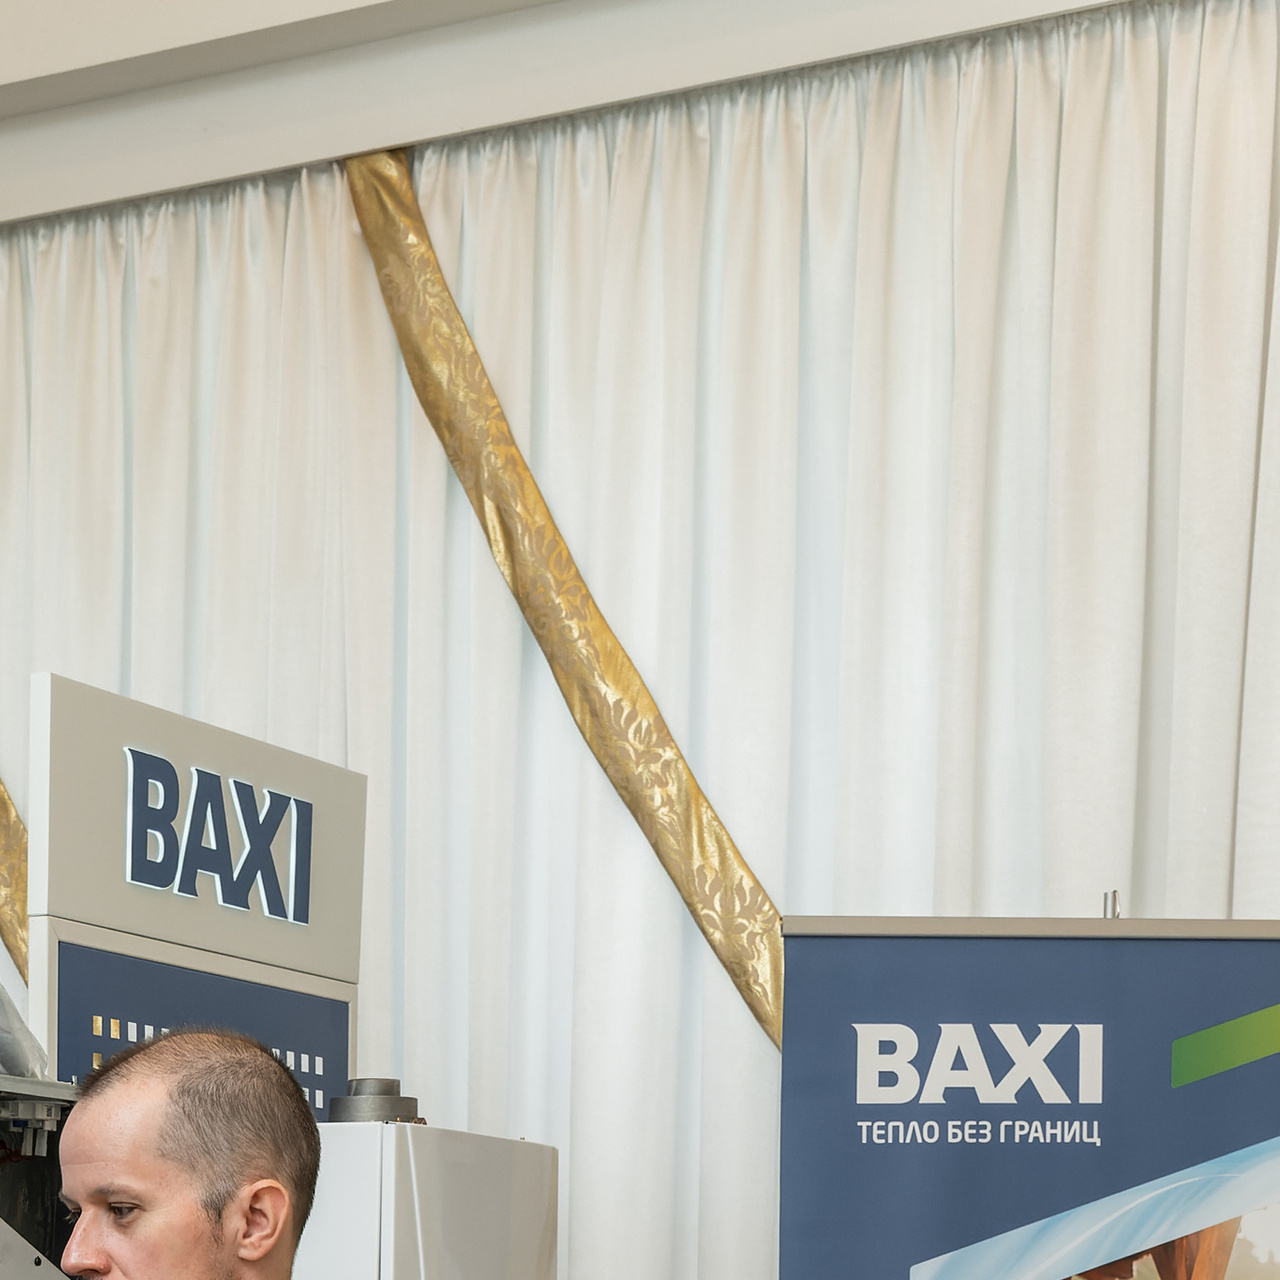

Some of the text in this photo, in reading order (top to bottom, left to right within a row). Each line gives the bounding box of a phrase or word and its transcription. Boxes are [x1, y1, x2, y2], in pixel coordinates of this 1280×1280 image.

[124, 746, 313, 926] BAXI
[852, 1023, 1104, 1105] BAXI
[857, 1120, 1102, 1147] ТЕПЛО БЕЗ ГРАНИЦ
